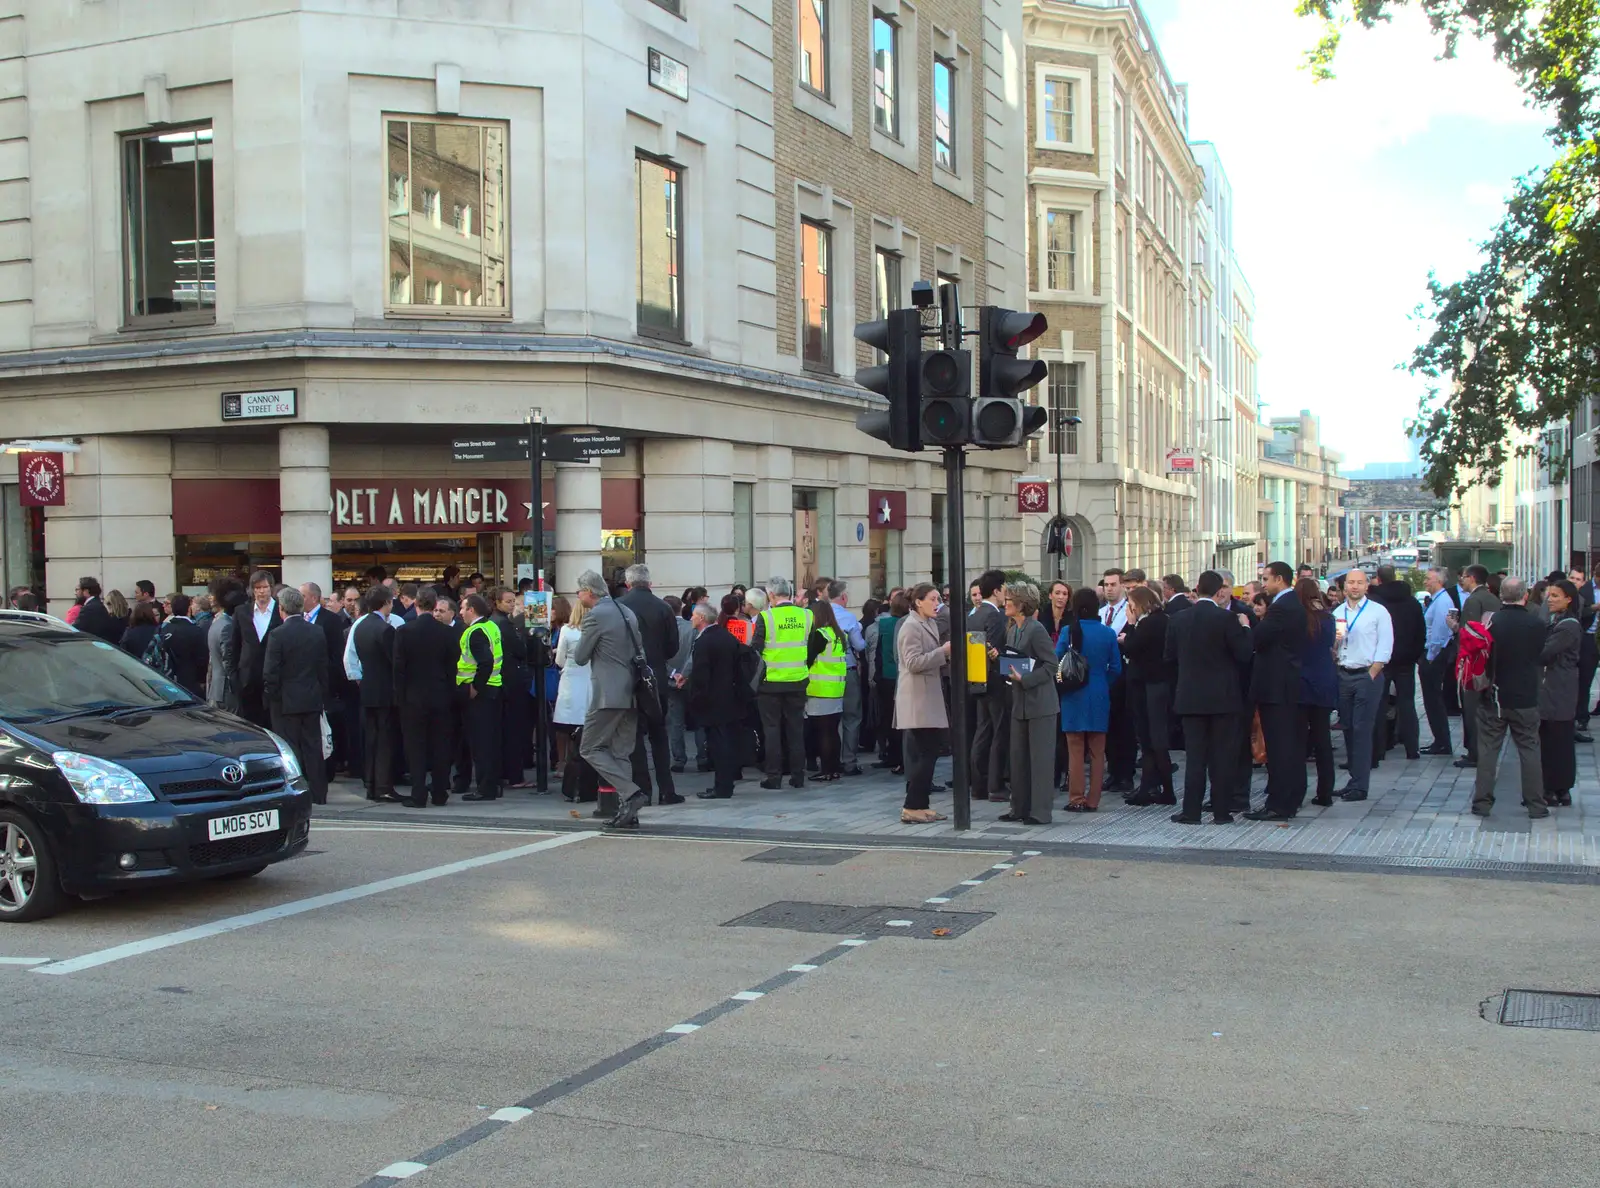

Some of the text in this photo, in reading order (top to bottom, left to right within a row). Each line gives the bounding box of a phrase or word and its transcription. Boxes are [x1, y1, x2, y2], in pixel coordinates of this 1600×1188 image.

[247, 395, 279, 404] CANNON
[247, 404, 289, 413] STREET EC4
[388, 488, 404, 525] A
[413, 488, 509, 524] MANGER
[214, 812, 272, 835] LM06 SCV
